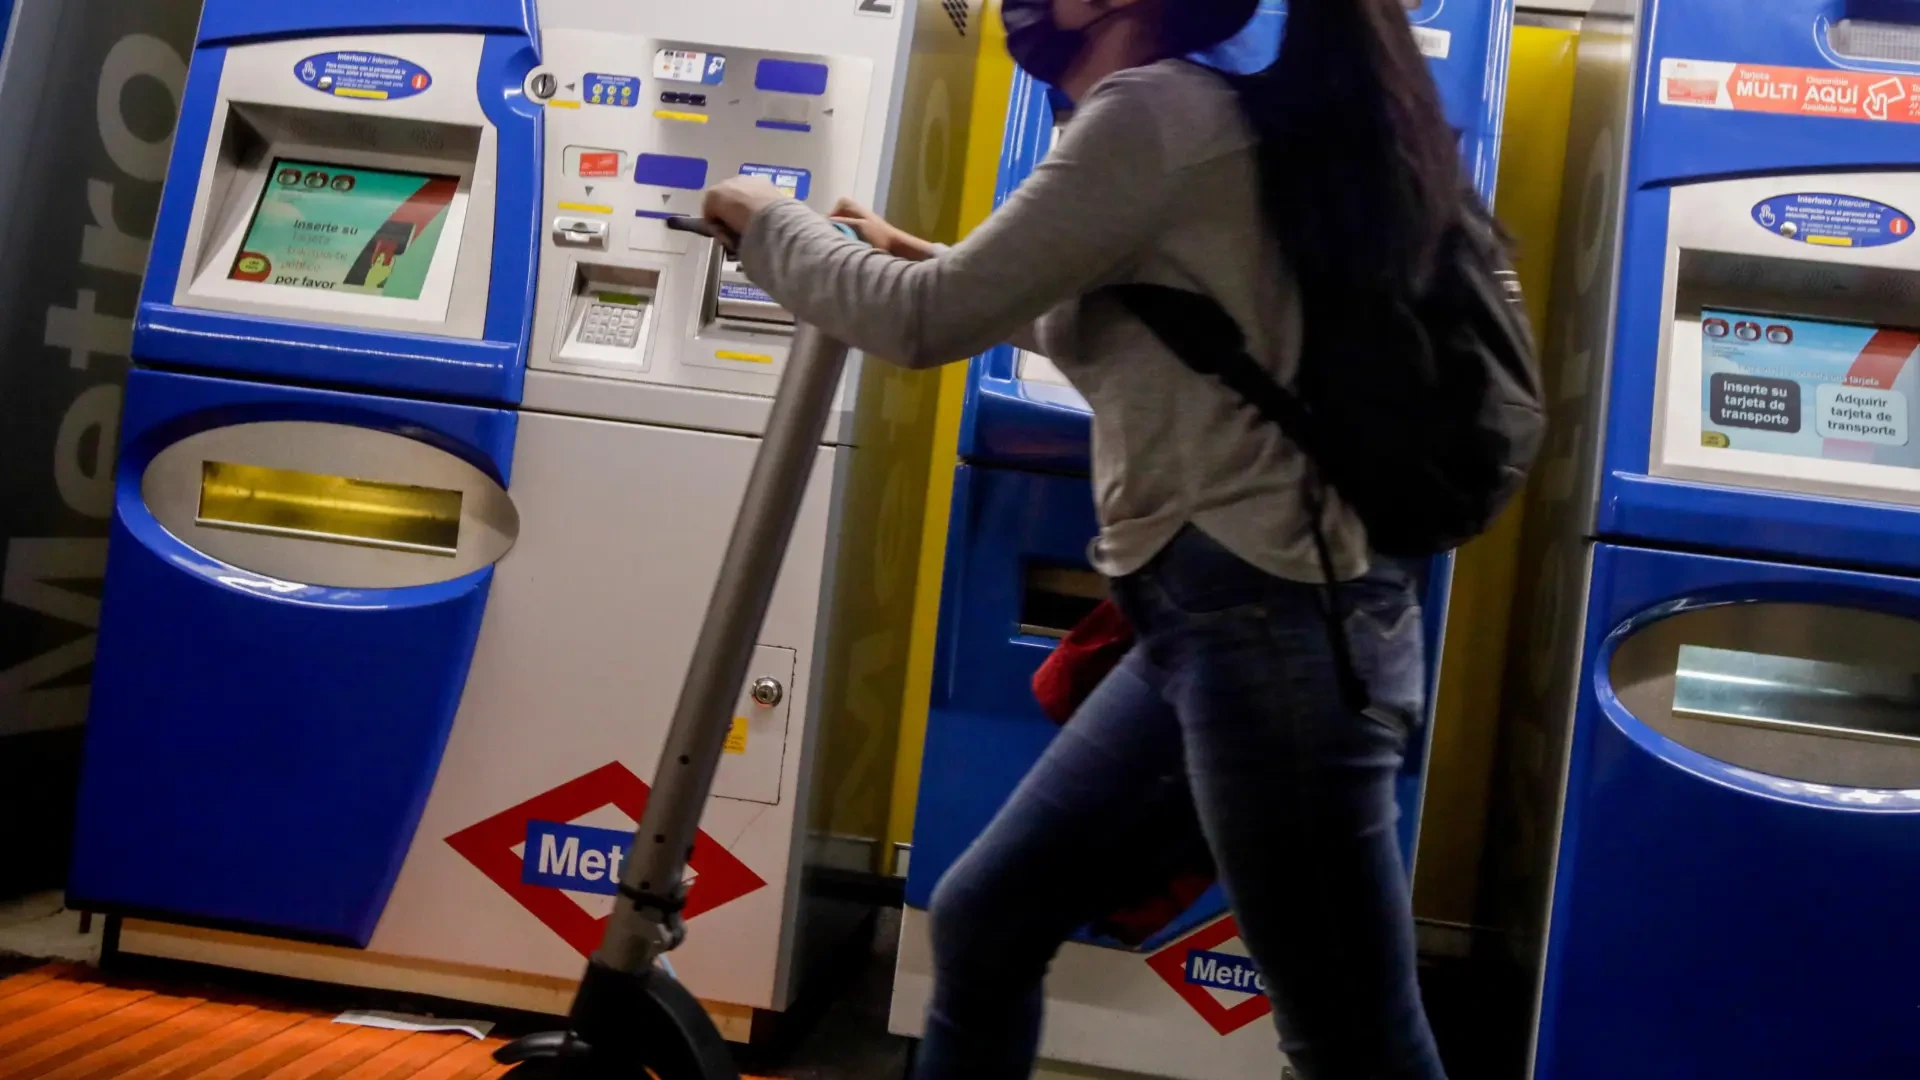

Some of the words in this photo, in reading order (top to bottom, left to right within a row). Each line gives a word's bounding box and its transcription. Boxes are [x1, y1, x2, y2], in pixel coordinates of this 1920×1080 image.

[1739, 70, 1770, 82] Tarjeta
[1736, 81, 1798, 100] MULTI
[1804, 83, 1859, 104] AQUÍ
[1797, 195, 1832, 206] Interfono
[293, 219, 339, 233] Inserte
[342, 226, 358, 235] su
[274, 276, 299, 285] por
[302, 276, 337, 289] favor
[1723, 380, 1768, 396] Inserte
[1771, 385, 1788, 397] su
[1849, 375, 1880, 386] tarjeta
[1724, 395, 1766, 411] tarjeta
[1769, 398, 1785, 411] de
[1834, 393, 1889, 409] Adquirir
[1721, 408, 1790, 425] transporte
[1830, 406, 1874, 422] tarjeta
[1876, 409, 1893, 422] de
[1827, 419, 1897, 437] transporte
[538, 833, 624, 884] Met
